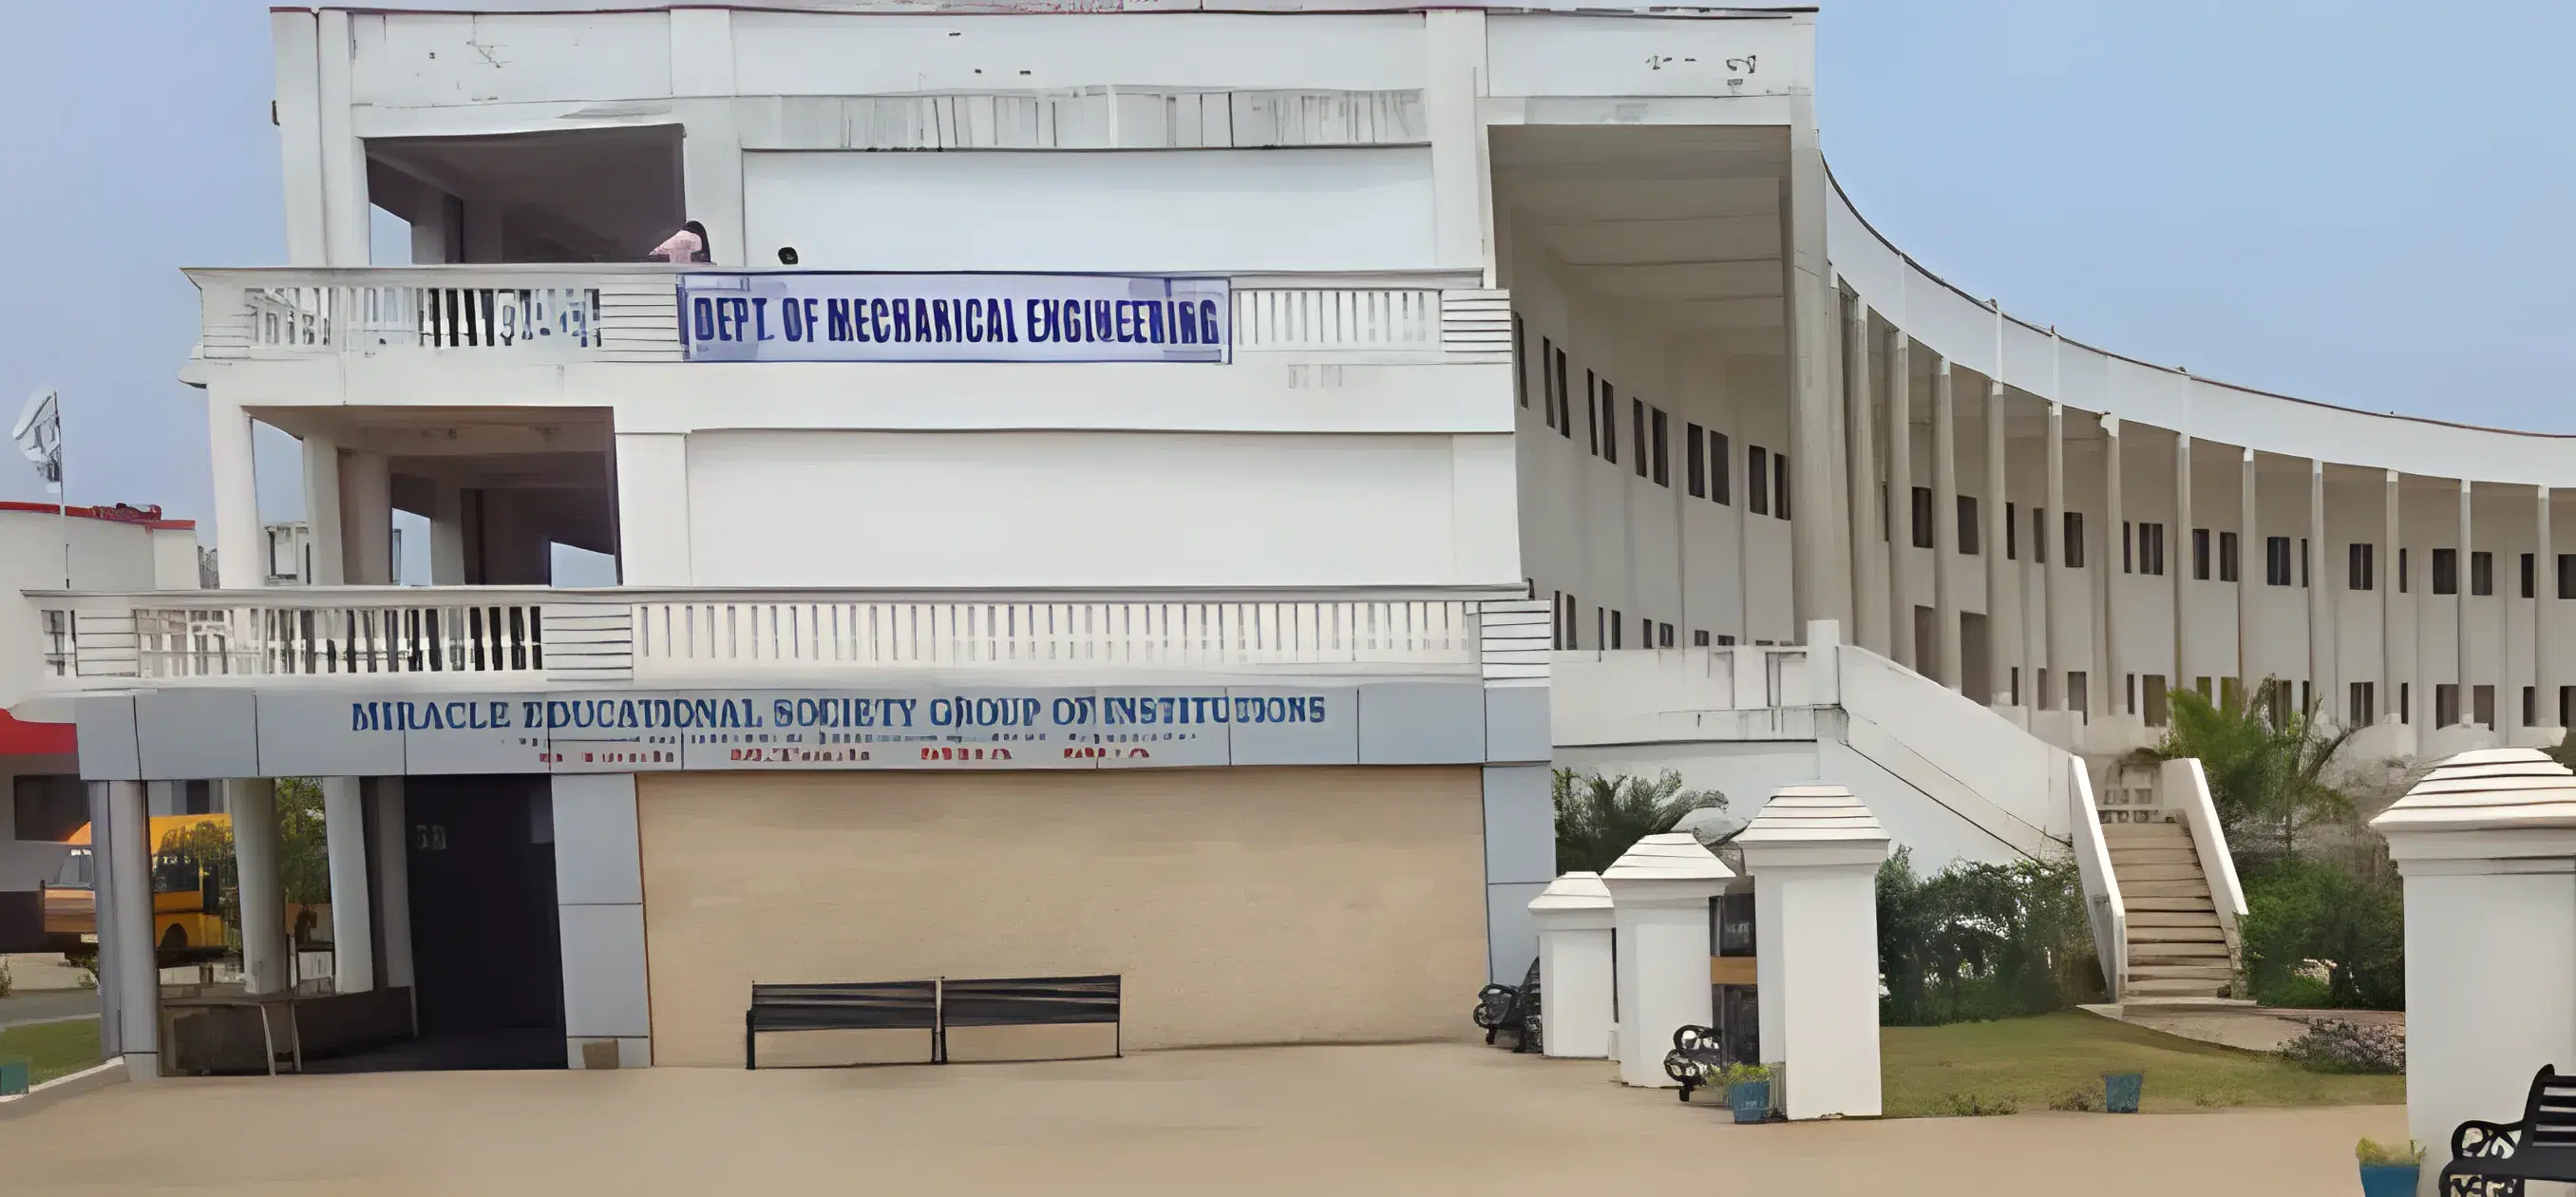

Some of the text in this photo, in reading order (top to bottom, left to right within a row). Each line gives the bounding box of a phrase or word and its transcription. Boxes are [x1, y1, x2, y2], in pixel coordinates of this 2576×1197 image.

[782, 297, 819, 343] OF
[826, 297, 1019, 343] MECHANICAL
[1027, 298, 1221, 345] ENGINEERING
[351, 695, 1326, 732] MIRACLE EDUCATIONAL SOCIETY GROUP OF INSTITUTIONS
